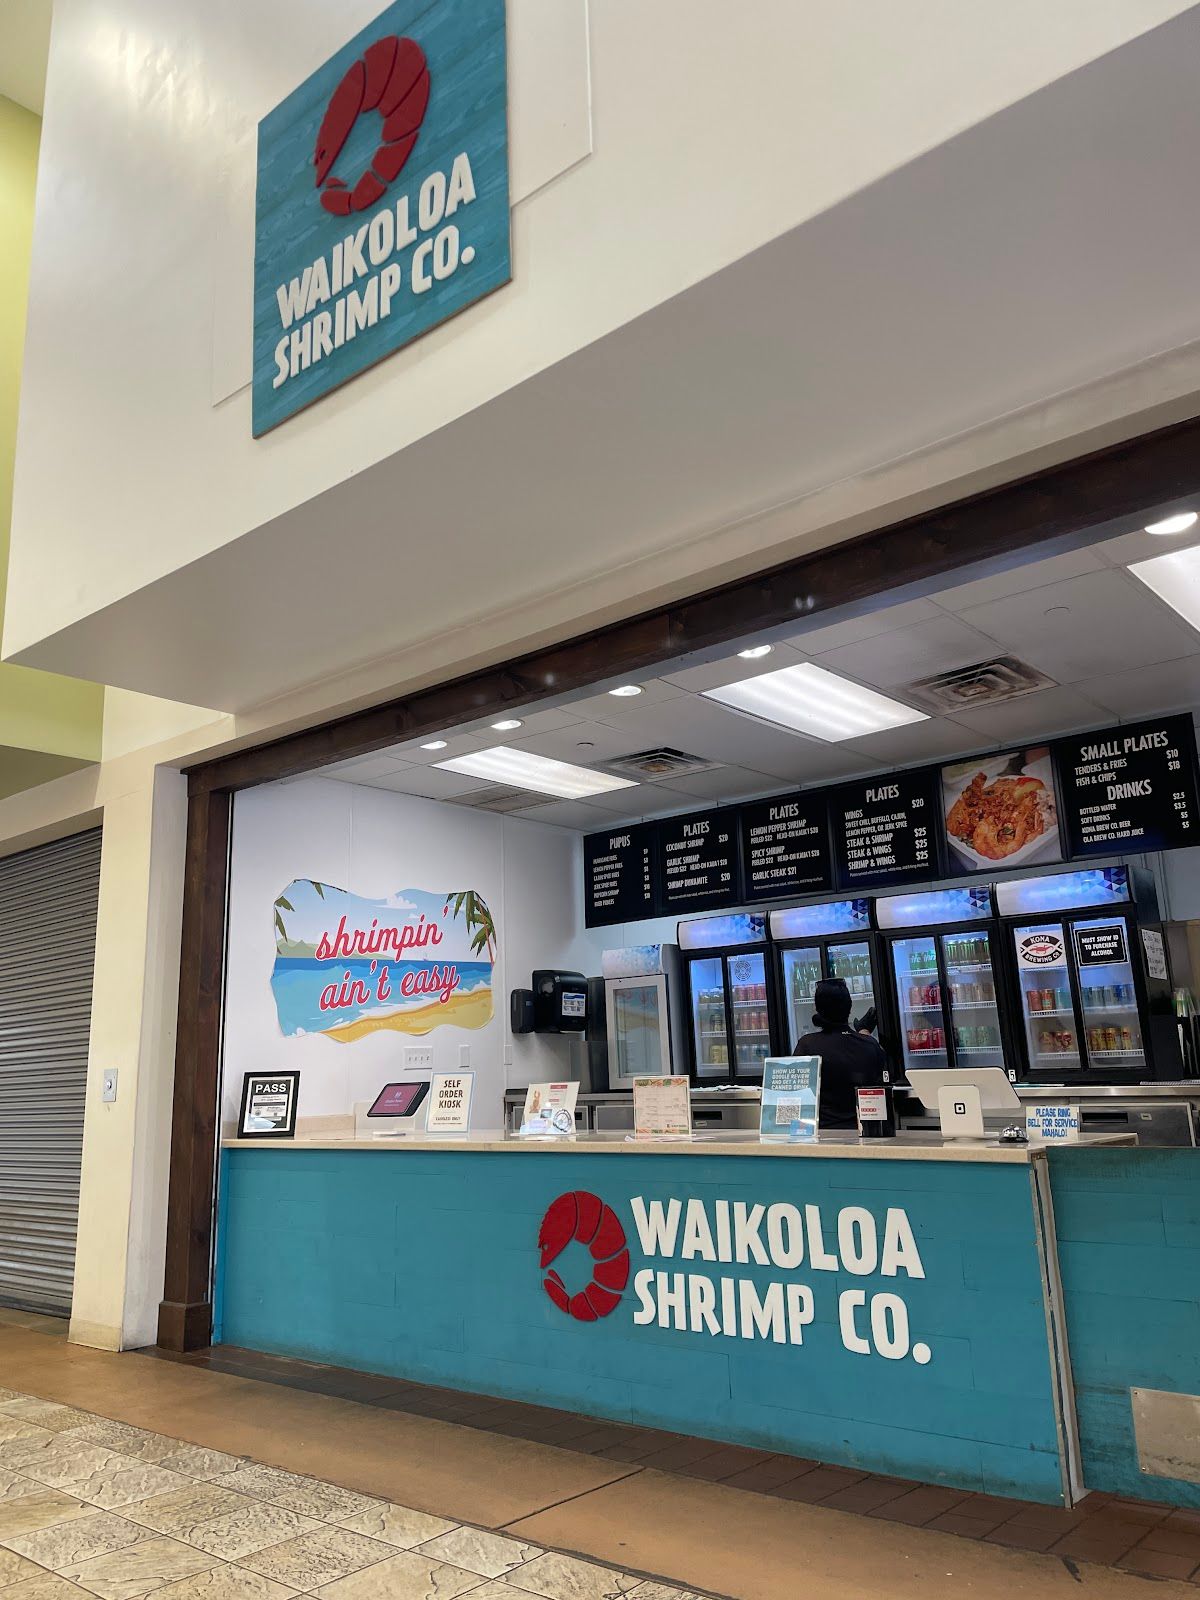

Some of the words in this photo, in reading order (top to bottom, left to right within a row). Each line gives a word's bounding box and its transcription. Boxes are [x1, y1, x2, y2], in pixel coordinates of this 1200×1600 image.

[276, 152, 476, 330] WAIKOLOA
[273, 263, 401, 389] SHRIMP
[411, 225, 475, 294] CO.
[1081, 741, 1121, 761] SMALL
[1124, 731, 1168, 753] PLATES
[1075, 763, 1101, 775] TENDERS
[1103, 762, 1109, 770] &
[1110, 758, 1127, 769] FRIES
[1166, 749, 1178, 759] $10
[1076, 777, 1090, 787] FISH
[1092, 776, 1097, 784] &
[1098, 772, 1116, 783] CHIPS
[1168, 760, 1180, 771] $18
[866, 784, 899, 802] PLATES
[1107, 779, 1152, 800] DRINKS
[770, 803, 799, 820] PLATES
[845, 809, 863, 820] WINGS
[912, 798, 924, 808] $20
[1080, 806, 1100, 815] BOTTLED
[1100, 804, 1116, 812] WATER
[1081, 816, 1093, 824] SOFT
[1094, 814, 1110, 822] DRINKS
[684, 821, 709, 837] PLATES
[750, 826, 767, 836] LEMON
[768, 823, 786, 833] PEPPER
[787, 819, 806, 829] SHRIMP
[1082, 825, 1095, 833] KONA
[1096, 823, 1109, 831] BREW
[610, 835, 630, 850] PUPUS
[687, 838, 704, 848] SHRIMP
[719, 834, 728, 842] $20
[847, 838, 864, 848] STEAK
[872, 833, 893, 844] SHRIMP
[914, 827, 926, 837] $25
[1083, 835, 1093, 843] OLA
[1094, 832, 1107, 841] BREW
[1131, 828, 1144, 836] JUICE
[752, 849, 765, 858] SPICY
[766, 846, 785, 856] SHRIMP
[848, 849, 865, 859] STEAK
[867, 848, 871, 856] &
[872, 844, 892, 855] WINGS
[915, 839, 927, 849] $25
[848, 860, 868, 870] SHRIMP
[876, 855, 895, 866] WINGS
[916, 850, 928, 860] $25
[721, 873, 730, 881] $20
[753, 871, 769, 880] GARLIC
[770, 867, 786, 878] STEAK
[788, 866, 796, 875] $21
[1030, 936, 1050, 944] KONA
[1097, 935, 1112, 943] SHOW
[1025, 954, 1052, 963] BREWING
[319, 960, 391, 1011] ain't
[400, 965, 460, 1004] easy
[1010, 1070, 1015, 1080] 5
[256, 1084, 286, 1093] PASS
[444, 1080, 461, 1088] SELF
[439, 1090, 463, 1098] ORDER
[439, 1100, 461, 1108] KIOSK
[1036, 1108, 1056, 1117] PLEASE
[1058, 1108, 1070, 1117] RING
[1028, 1119, 1040, 1127] BELL
[1042, 1119, 1052, 1127] FOR
[1042, 1129, 1067, 1138] MAHALO!
[630, 1196, 926, 1279] WAIKOLOA
[633, 1268, 815, 1345] SHRIMP
[839, 1289, 932, 1365] CO.
